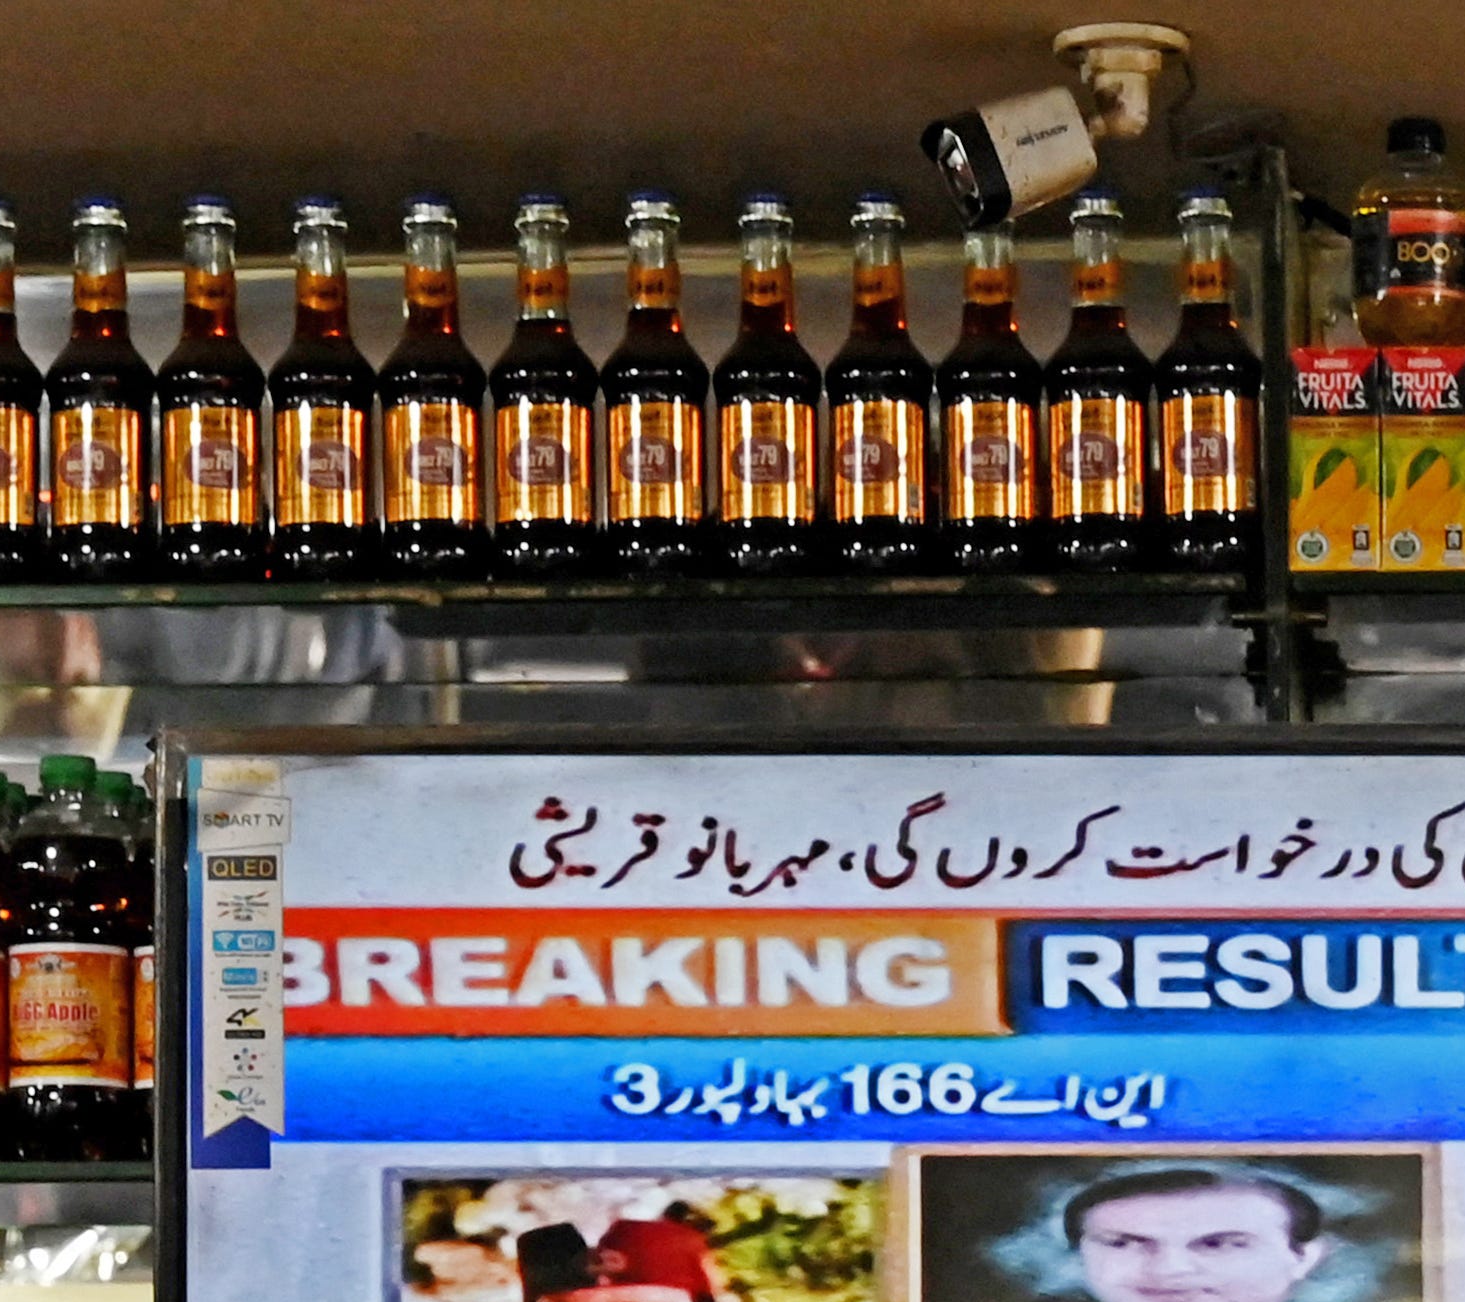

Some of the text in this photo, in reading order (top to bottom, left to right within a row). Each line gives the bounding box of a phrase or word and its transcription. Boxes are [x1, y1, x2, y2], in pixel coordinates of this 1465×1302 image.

[1298, 372, 1363, 390] FRUITA
[1299, 391, 1366, 409] VITALS
[212, 857, 274, 877] QLED
[509, 796, 666, 889] قریشی
[674, 816, 830, 897] مہربانو
[935, 805, 1121, 889] کروں
[1106, 818, 1380, 880] درخواست
[282, 935, 950, 1009] BREAKING
[48, 1002, 99, 1023] Apple
